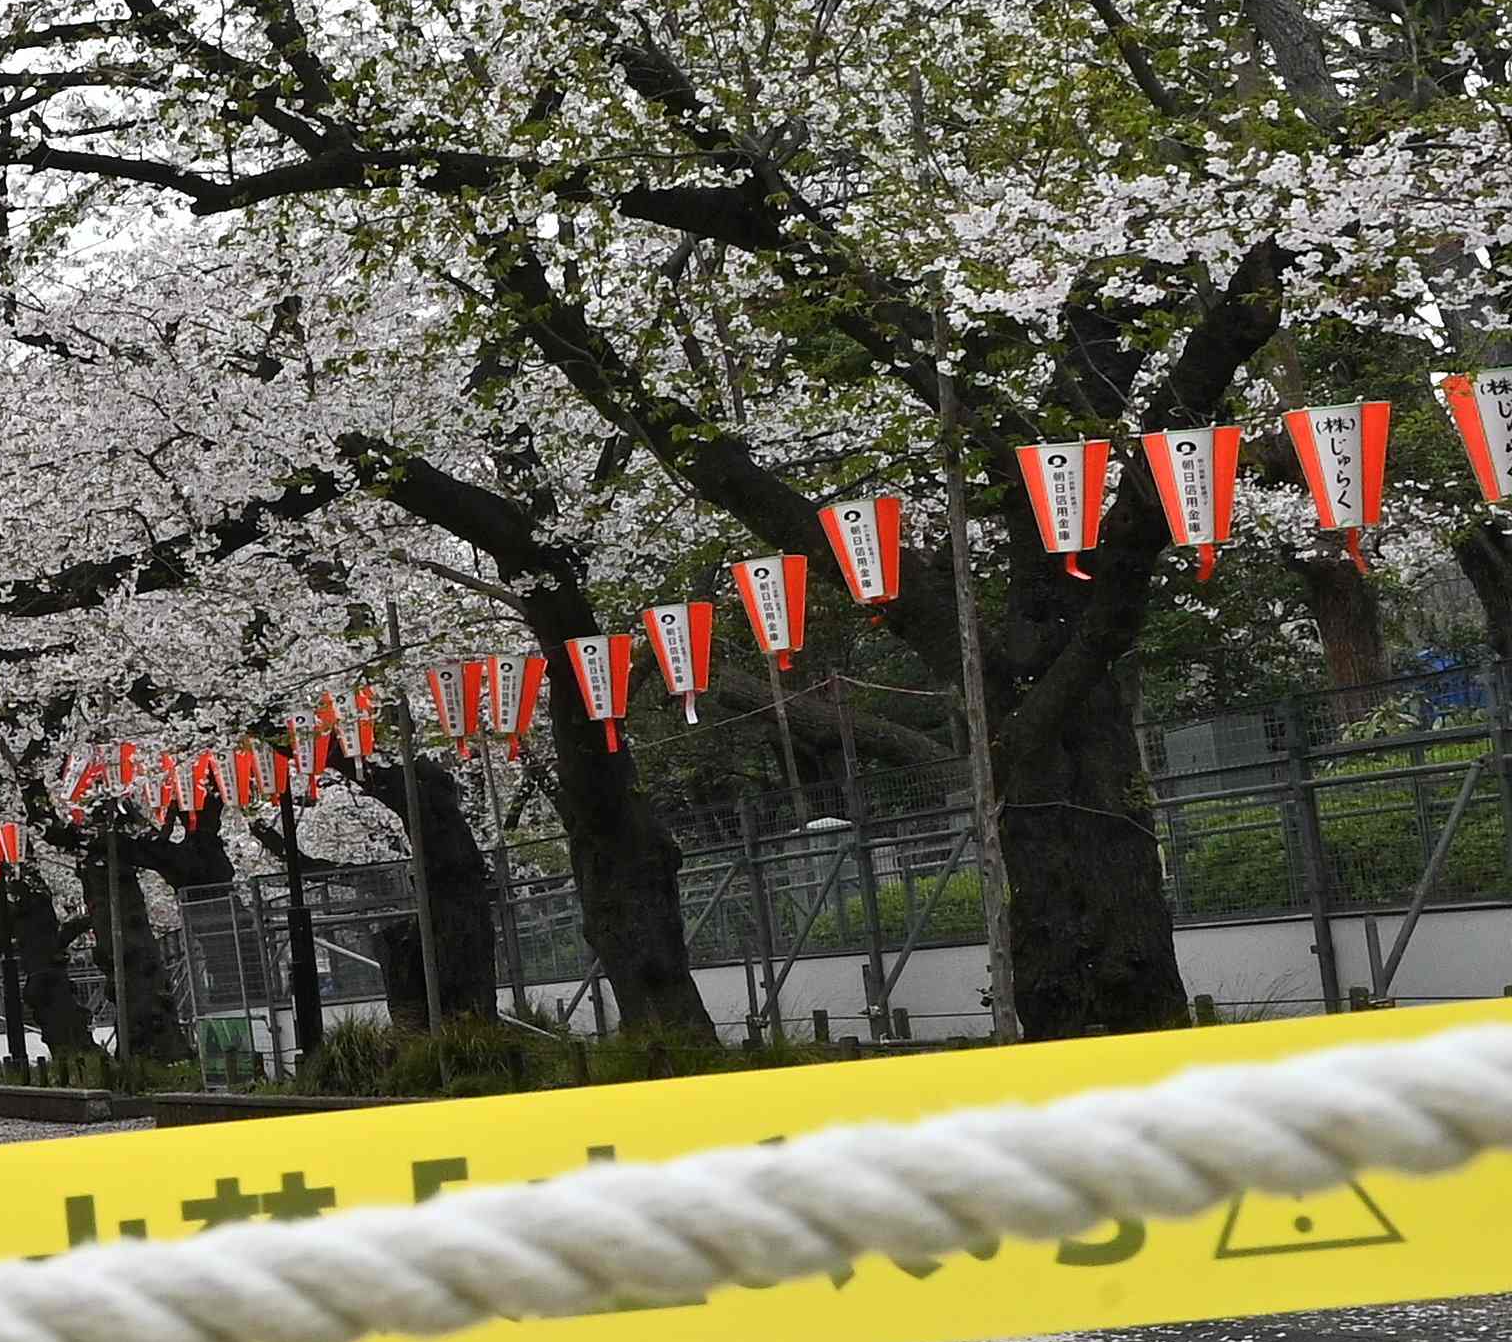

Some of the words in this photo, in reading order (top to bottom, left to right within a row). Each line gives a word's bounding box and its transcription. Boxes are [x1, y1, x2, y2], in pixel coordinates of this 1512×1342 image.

[1052, 471, 1071, 541] 朝日信用金庫
[1181, 459, 1201, 533] 朝日信用金庫
